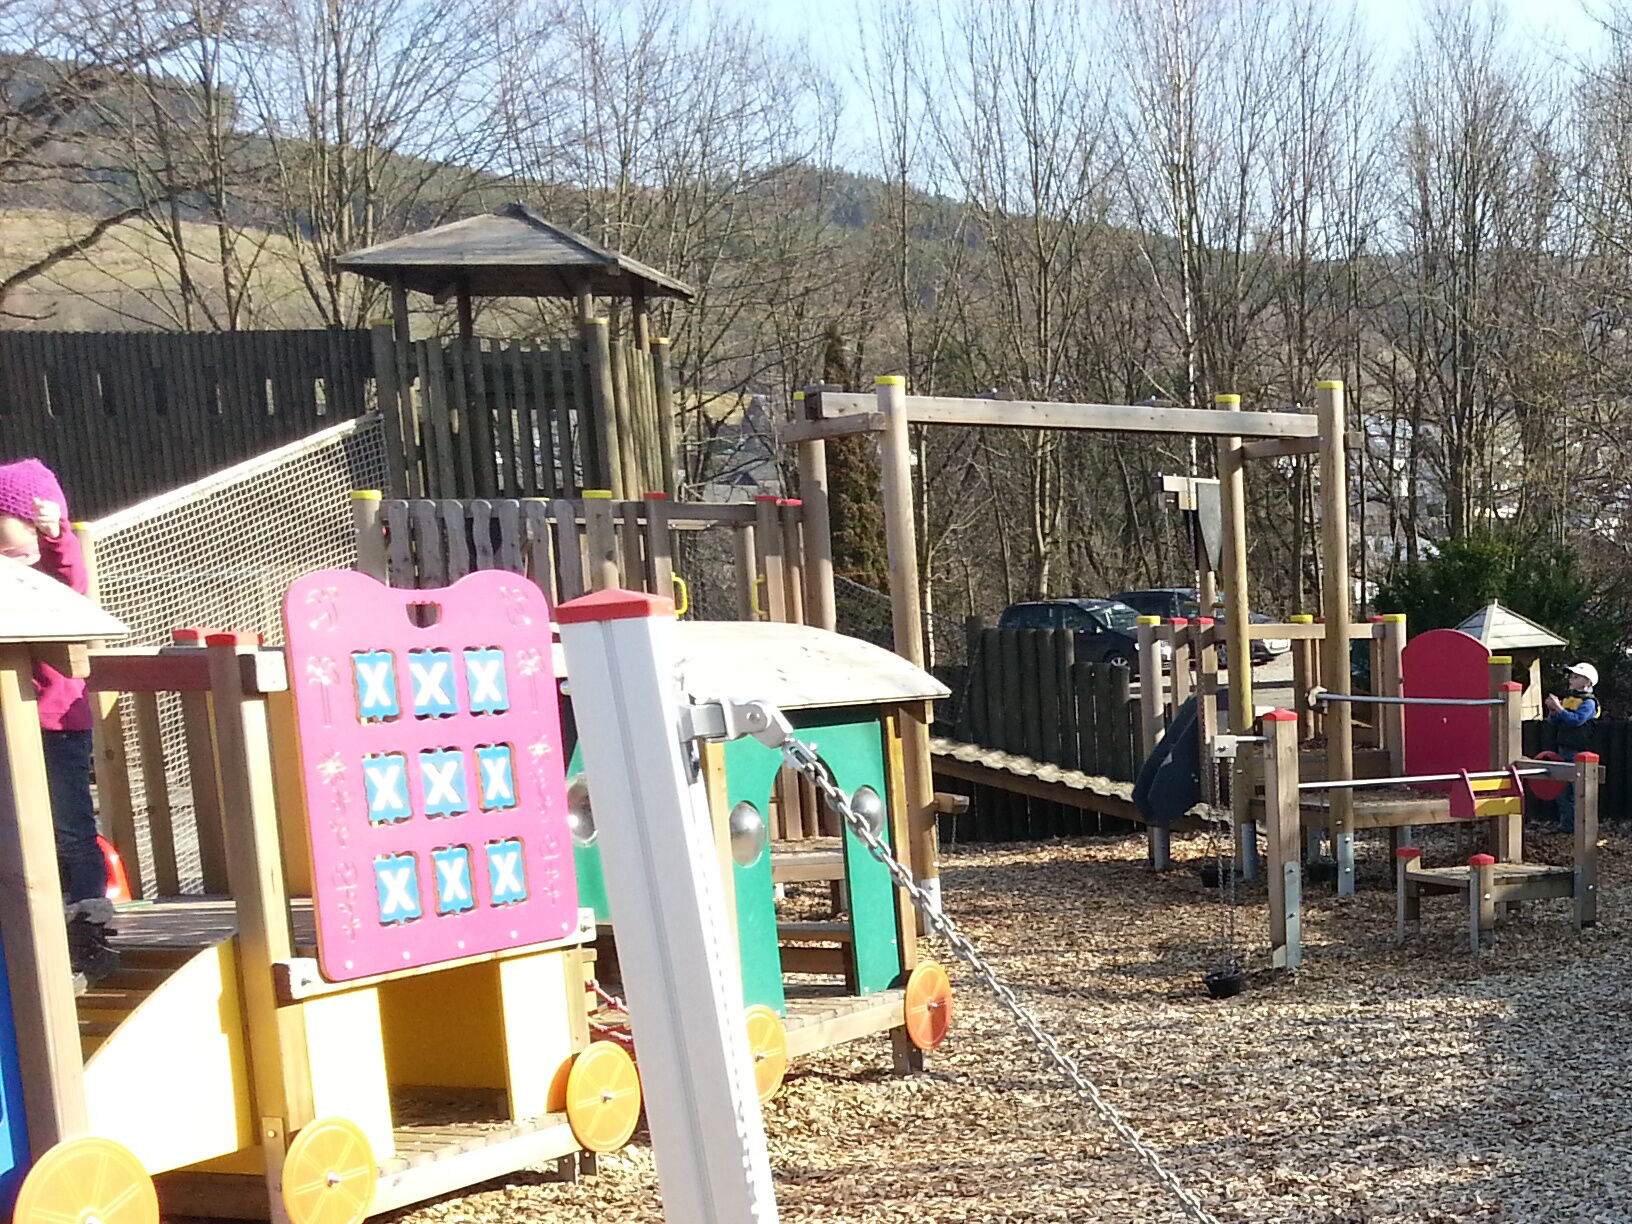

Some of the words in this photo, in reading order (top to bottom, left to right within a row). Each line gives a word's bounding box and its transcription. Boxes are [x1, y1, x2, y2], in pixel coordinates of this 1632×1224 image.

[361, 662, 391, 707] X
[412, 662, 451, 706] X
[471, 659, 502, 703] X
[368, 765, 403, 811] X
[423, 761, 461, 805] X
[485, 758, 510, 800] X
[379, 869, 416, 915] X
[441, 857, 467, 902] X
[493, 852, 522, 896] X
